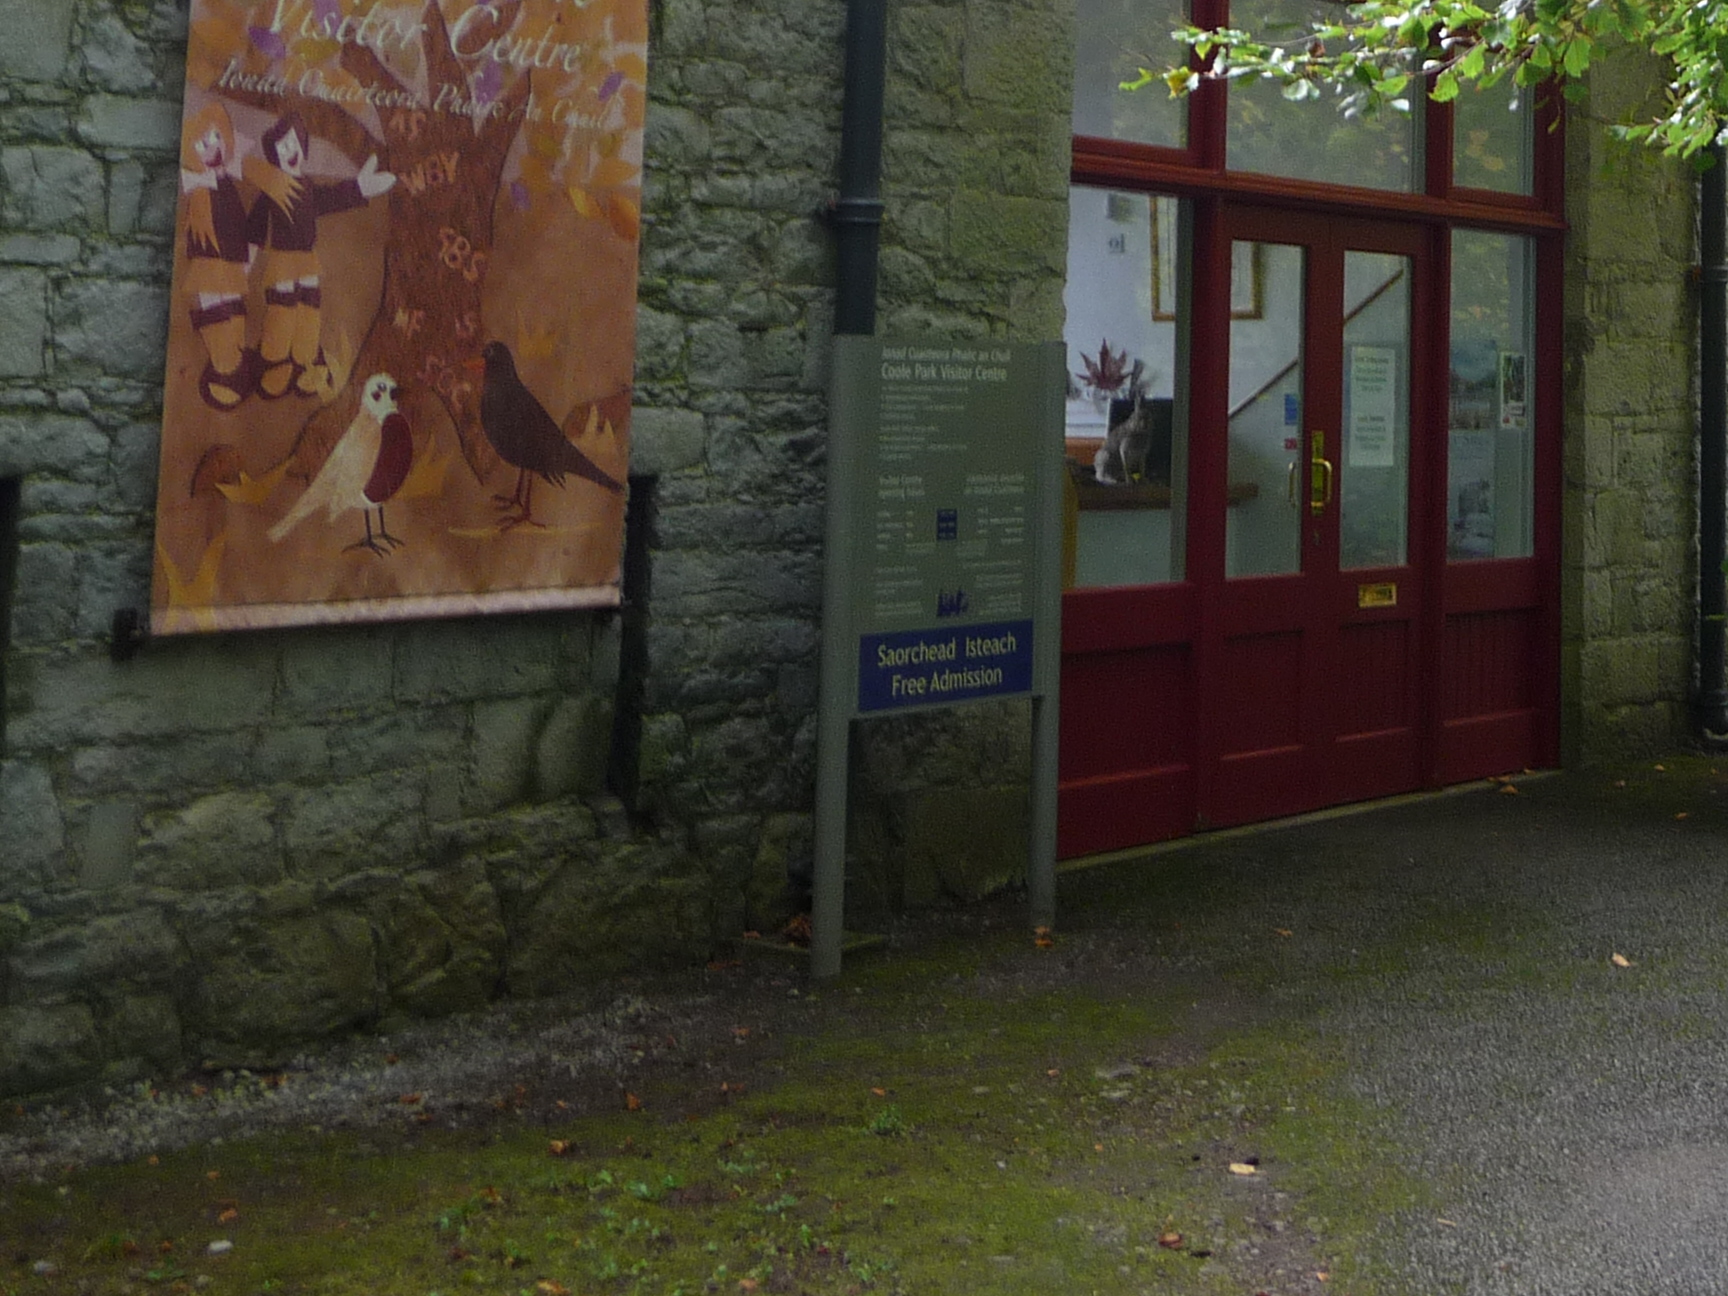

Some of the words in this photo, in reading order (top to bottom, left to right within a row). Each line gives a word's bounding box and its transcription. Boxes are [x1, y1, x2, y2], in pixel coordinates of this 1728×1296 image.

[451, 4, 581, 71] Centre
[881, 362, 911, 380] Coole
[915, 362, 937, 380] Park
[940, 363, 972, 381] Visitor
[975, 364, 1007, 382] Centre
[877, 637, 956, 668] Saorchead
[965, 631, 1017, 658] Isteach
[892, 674, 927, 697] Free
[930, 665, 1003, 693] Admission
